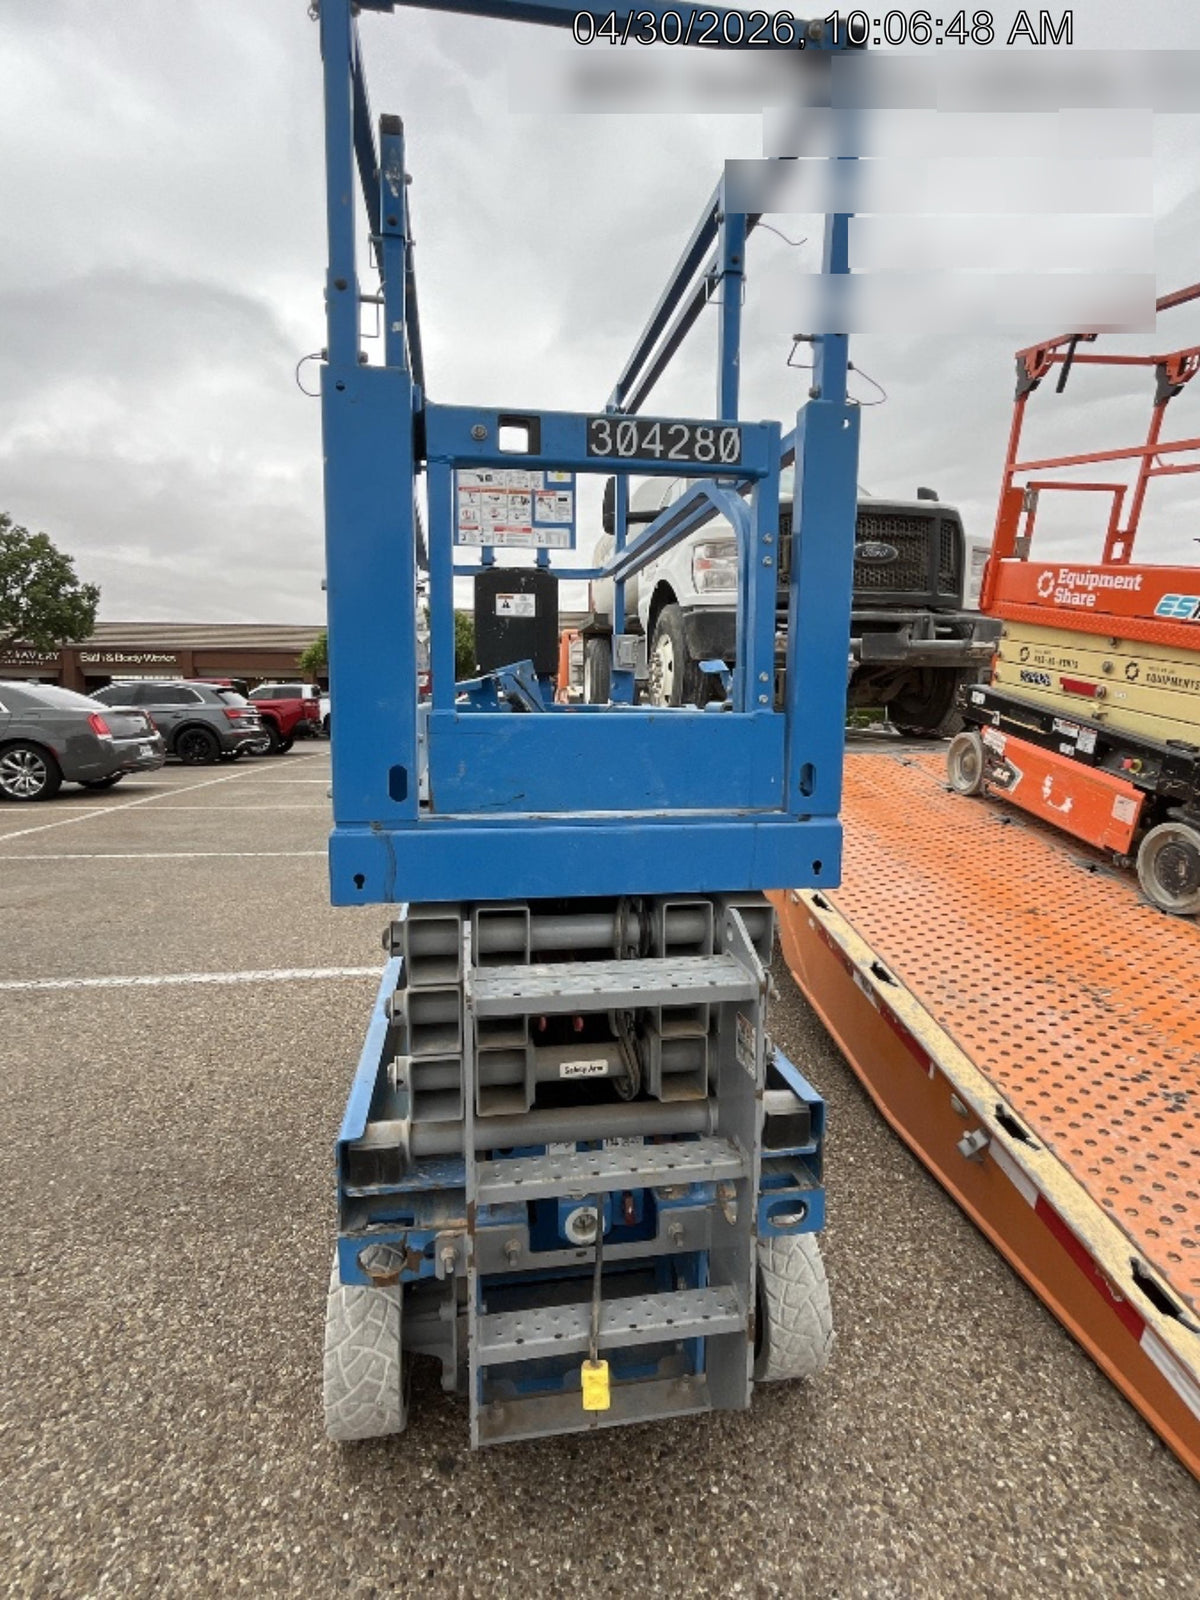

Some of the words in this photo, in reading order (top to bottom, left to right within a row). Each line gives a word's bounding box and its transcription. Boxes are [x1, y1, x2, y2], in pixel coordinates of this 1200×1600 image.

[591, 419, 740, 463] 304280
[1057, 568, 1143, 591] Equipment
[1053, 586, 1097, 607] Share
